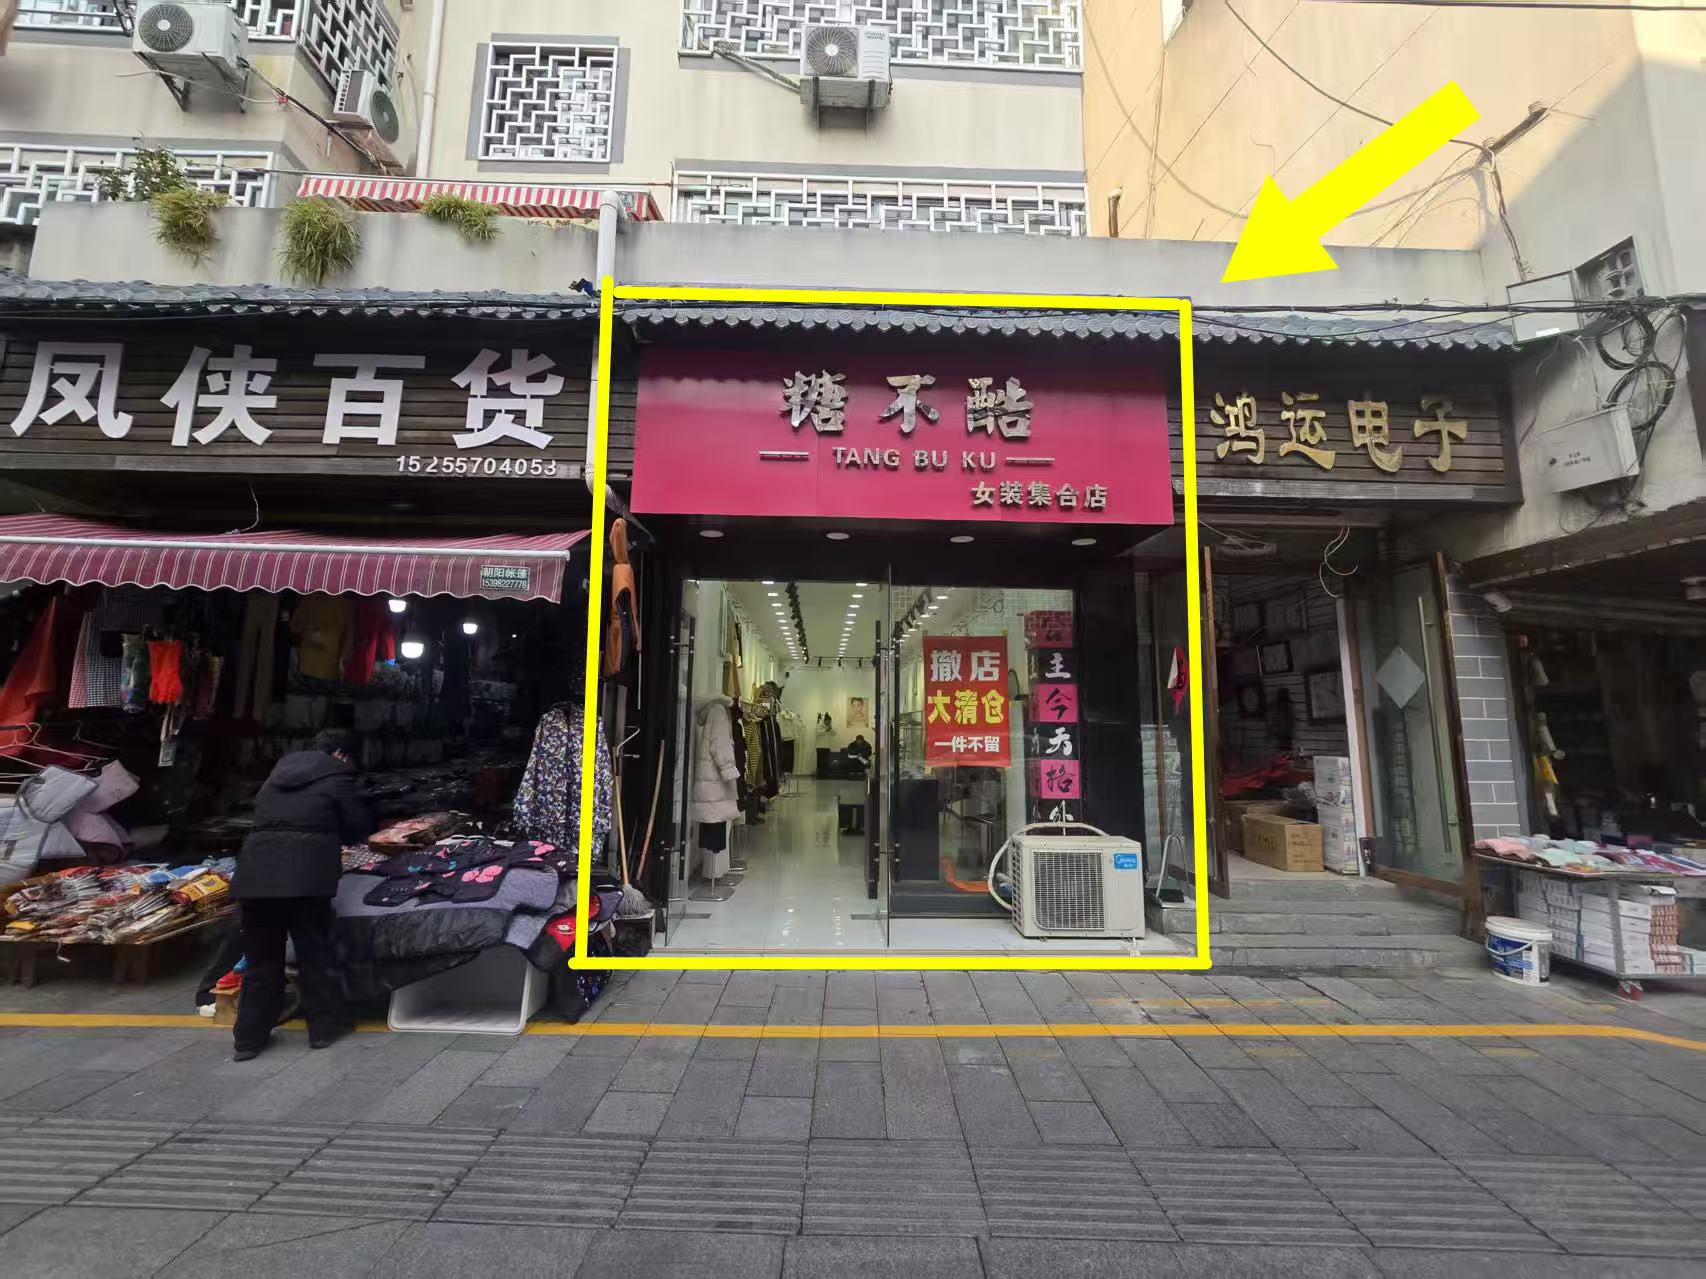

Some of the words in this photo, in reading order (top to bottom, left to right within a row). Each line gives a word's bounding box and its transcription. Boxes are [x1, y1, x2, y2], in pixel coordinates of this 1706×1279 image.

[10, 341, 565, 449] 凤侠百货
[780, 369, 1034, 437] 糖不酷
[1210, 391, 1468, 473] 鸿运电子
[396, 455, 557, 475] 15255704053
[832, 446, 900, 467] TANG
[914, 450, 948, 468] BU
[962, 451, 996, 469] KU
[971, 481, 1108, 509] 女装集合店
[931, 650, 1000, 682] 撤店
[928, 690, 1005, 725] 大清仓
[934, 736, 1000, 752] 一件不留
